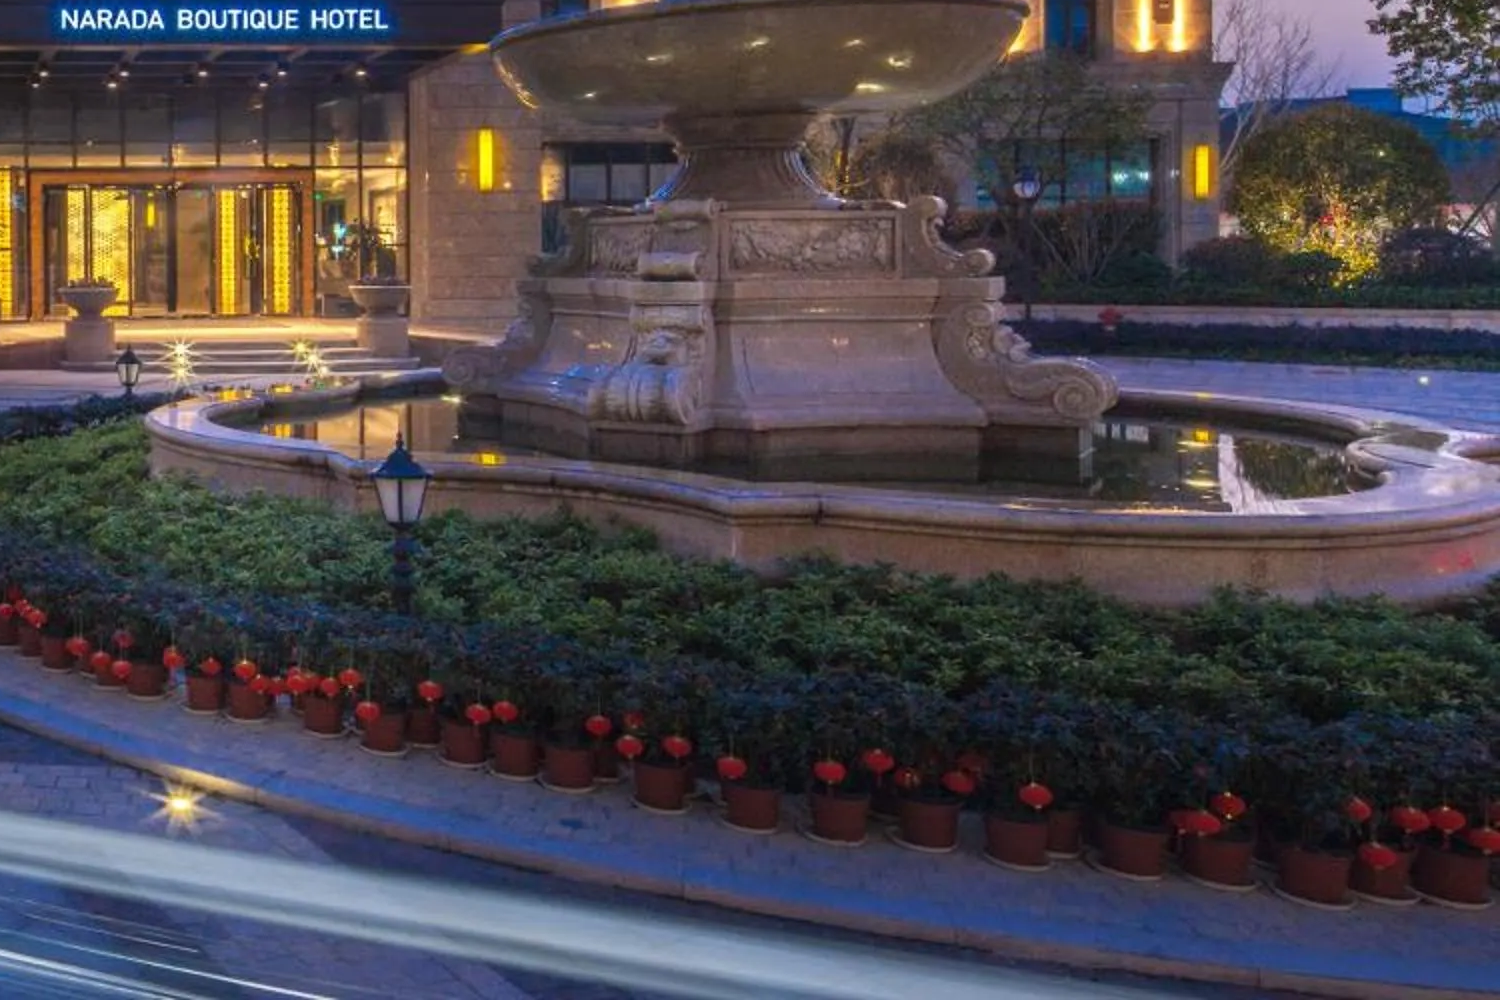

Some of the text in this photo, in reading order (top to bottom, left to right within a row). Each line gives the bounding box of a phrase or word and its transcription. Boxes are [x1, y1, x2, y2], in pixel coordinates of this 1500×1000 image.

[60, 8, 390, 30] NARADA BOUTIQUE HOTEL
